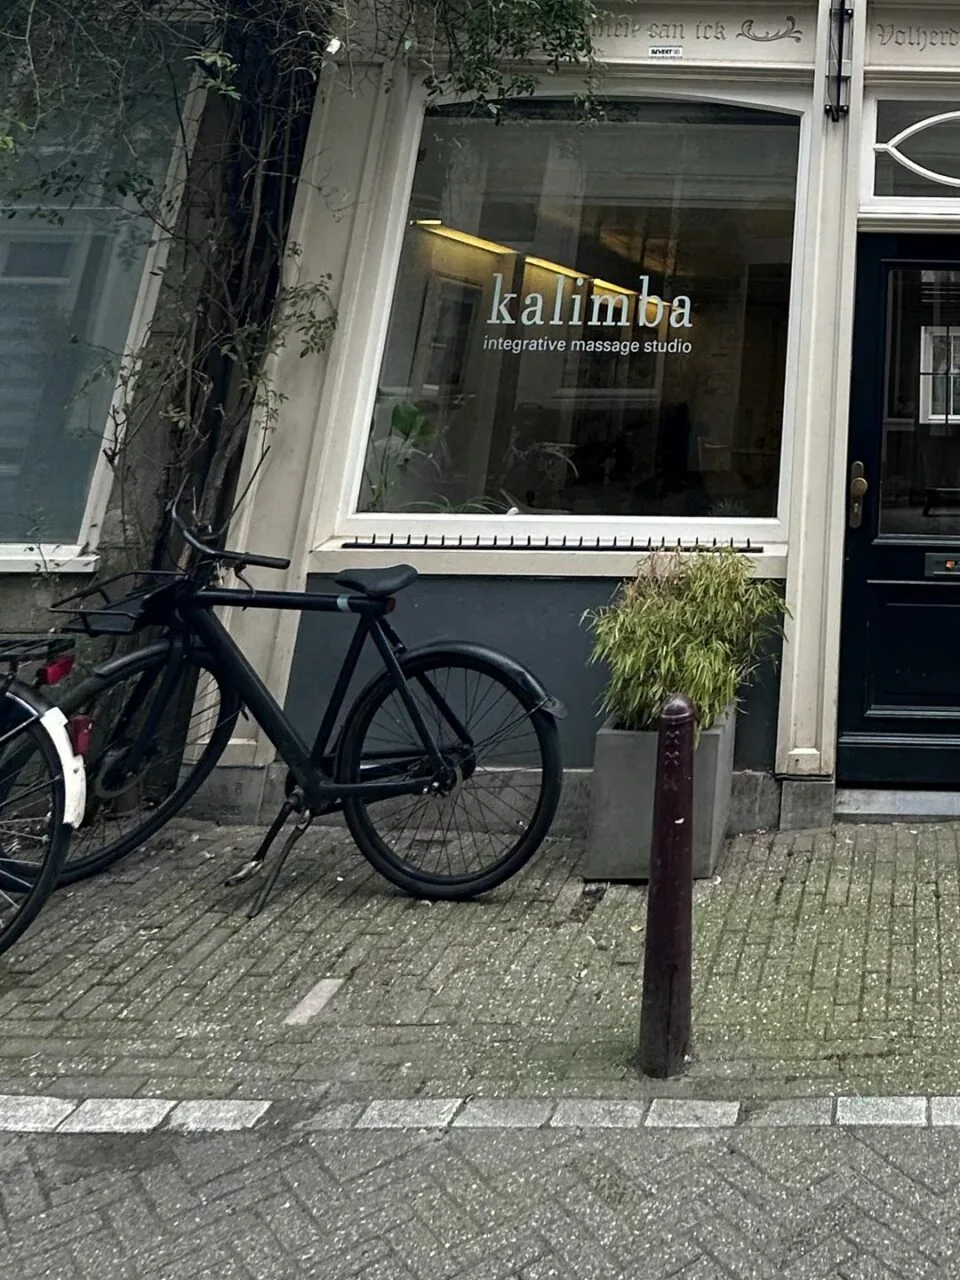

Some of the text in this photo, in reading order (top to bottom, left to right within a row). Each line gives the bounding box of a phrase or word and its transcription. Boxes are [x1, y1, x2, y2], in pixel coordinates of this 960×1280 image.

[695, 20, 727, 40] ick
[486, 273, 693, 328] kalimba
[483, 335, 692, 355] integrative massage studio
